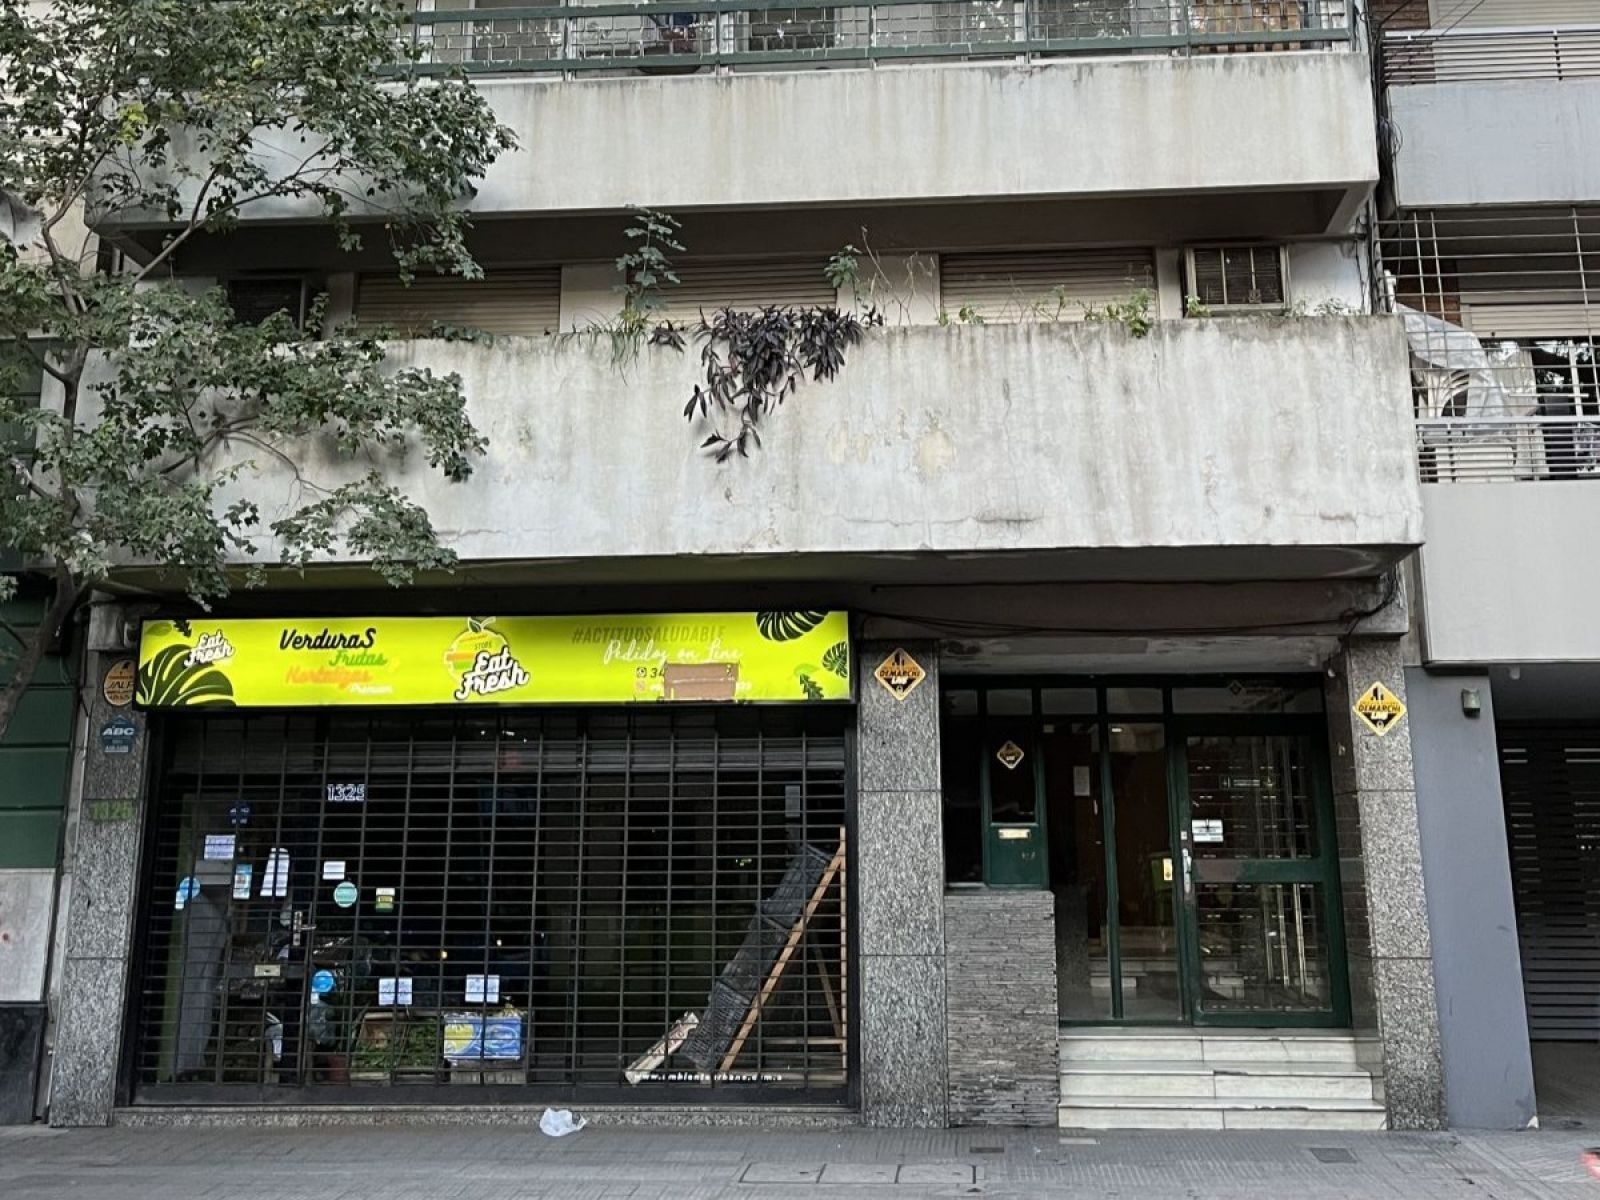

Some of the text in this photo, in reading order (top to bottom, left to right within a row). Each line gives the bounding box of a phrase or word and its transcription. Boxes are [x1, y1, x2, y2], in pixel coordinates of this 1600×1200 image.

[279, 627, 377, 650] VerduraS
[571, 625, 726, 645] #ACTITUDSALUDABLE
[474, 645, 513, 674] Eat
[454, 660, 529, 700] Fresh
